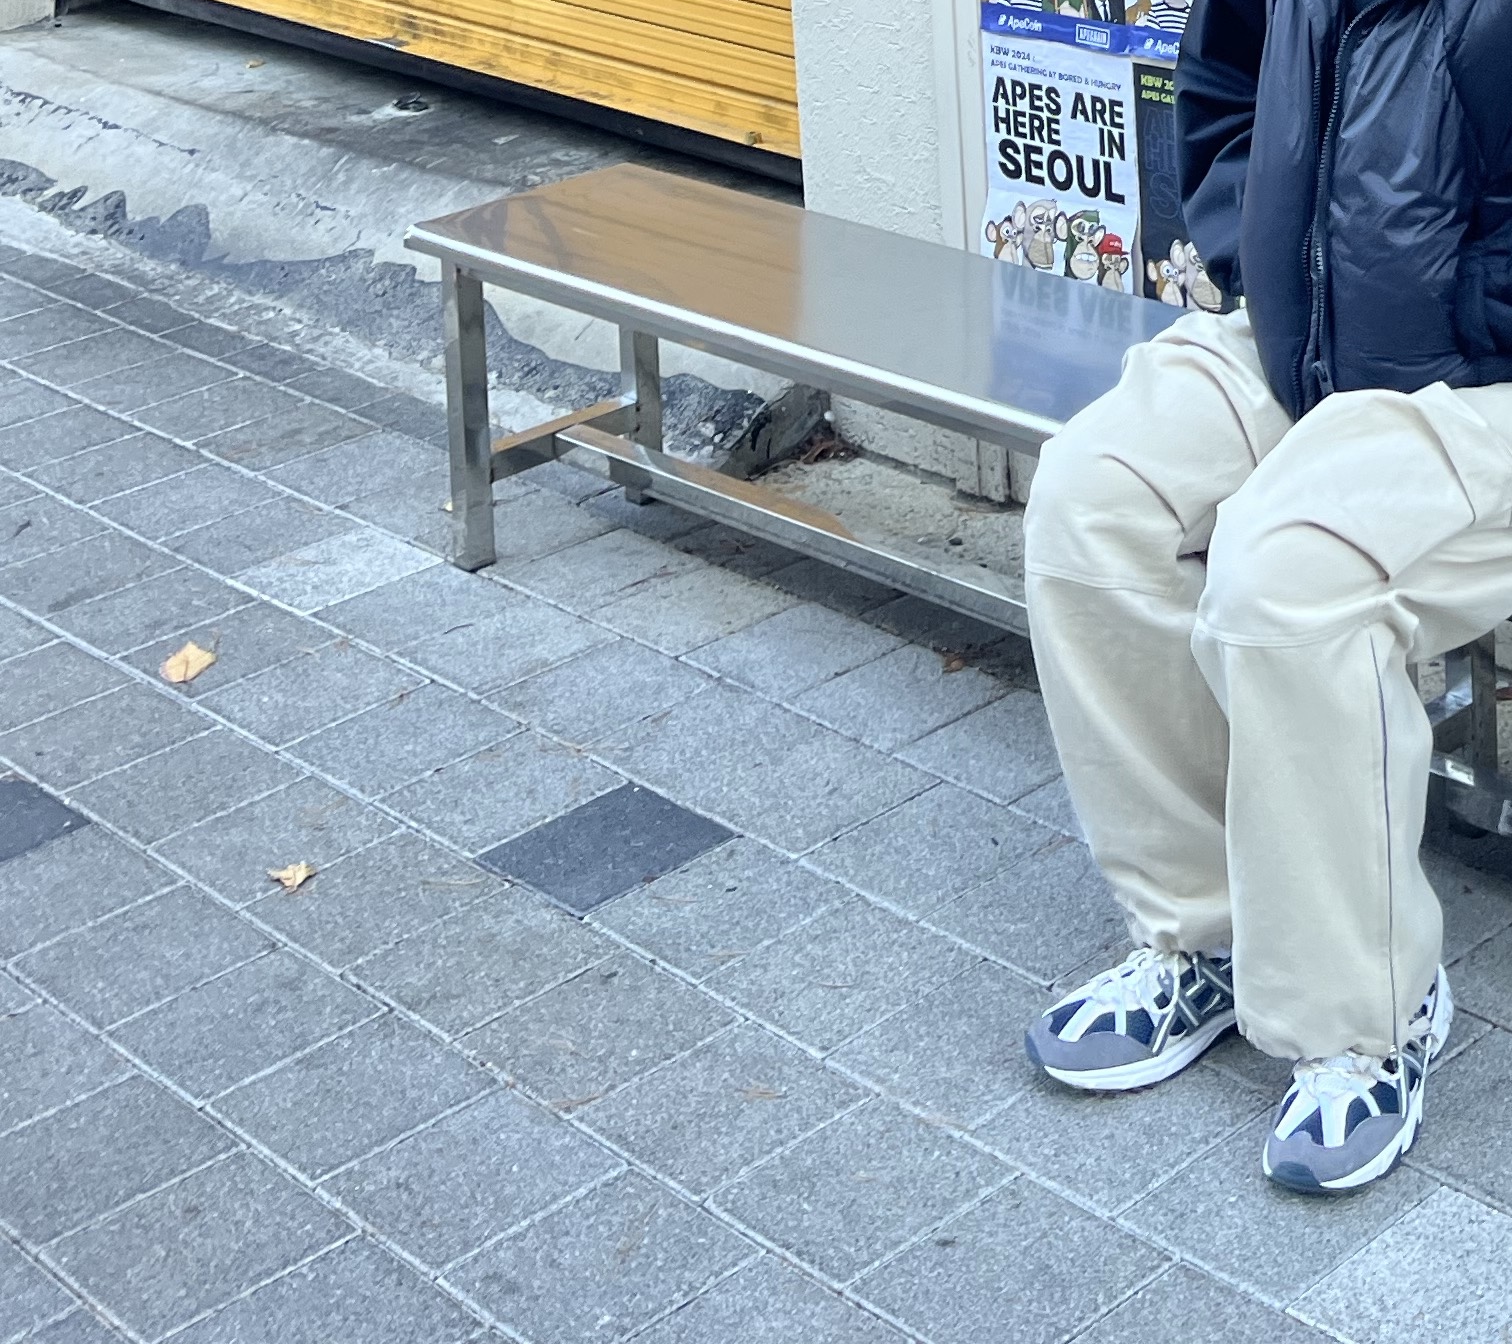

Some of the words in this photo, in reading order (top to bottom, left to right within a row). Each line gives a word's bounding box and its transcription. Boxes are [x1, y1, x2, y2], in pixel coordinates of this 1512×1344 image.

[1007, 16, 1042, 32] ApeCoin
[990, 45, 1009, 59] KBW
[1012, 50, 1031, 62] 2024
[1058, 72, 1083, 84] BORED
[1090, 78, 1121, 91] HUNGRY
[992, 76, 1061, 116] APES
[1070, 92, 1125, 130] ARE
[993, 106, 1061, 146] HERE
[1099, 127, 1125, 161] IN
[998, 139, 1125, 205] SEOUL
